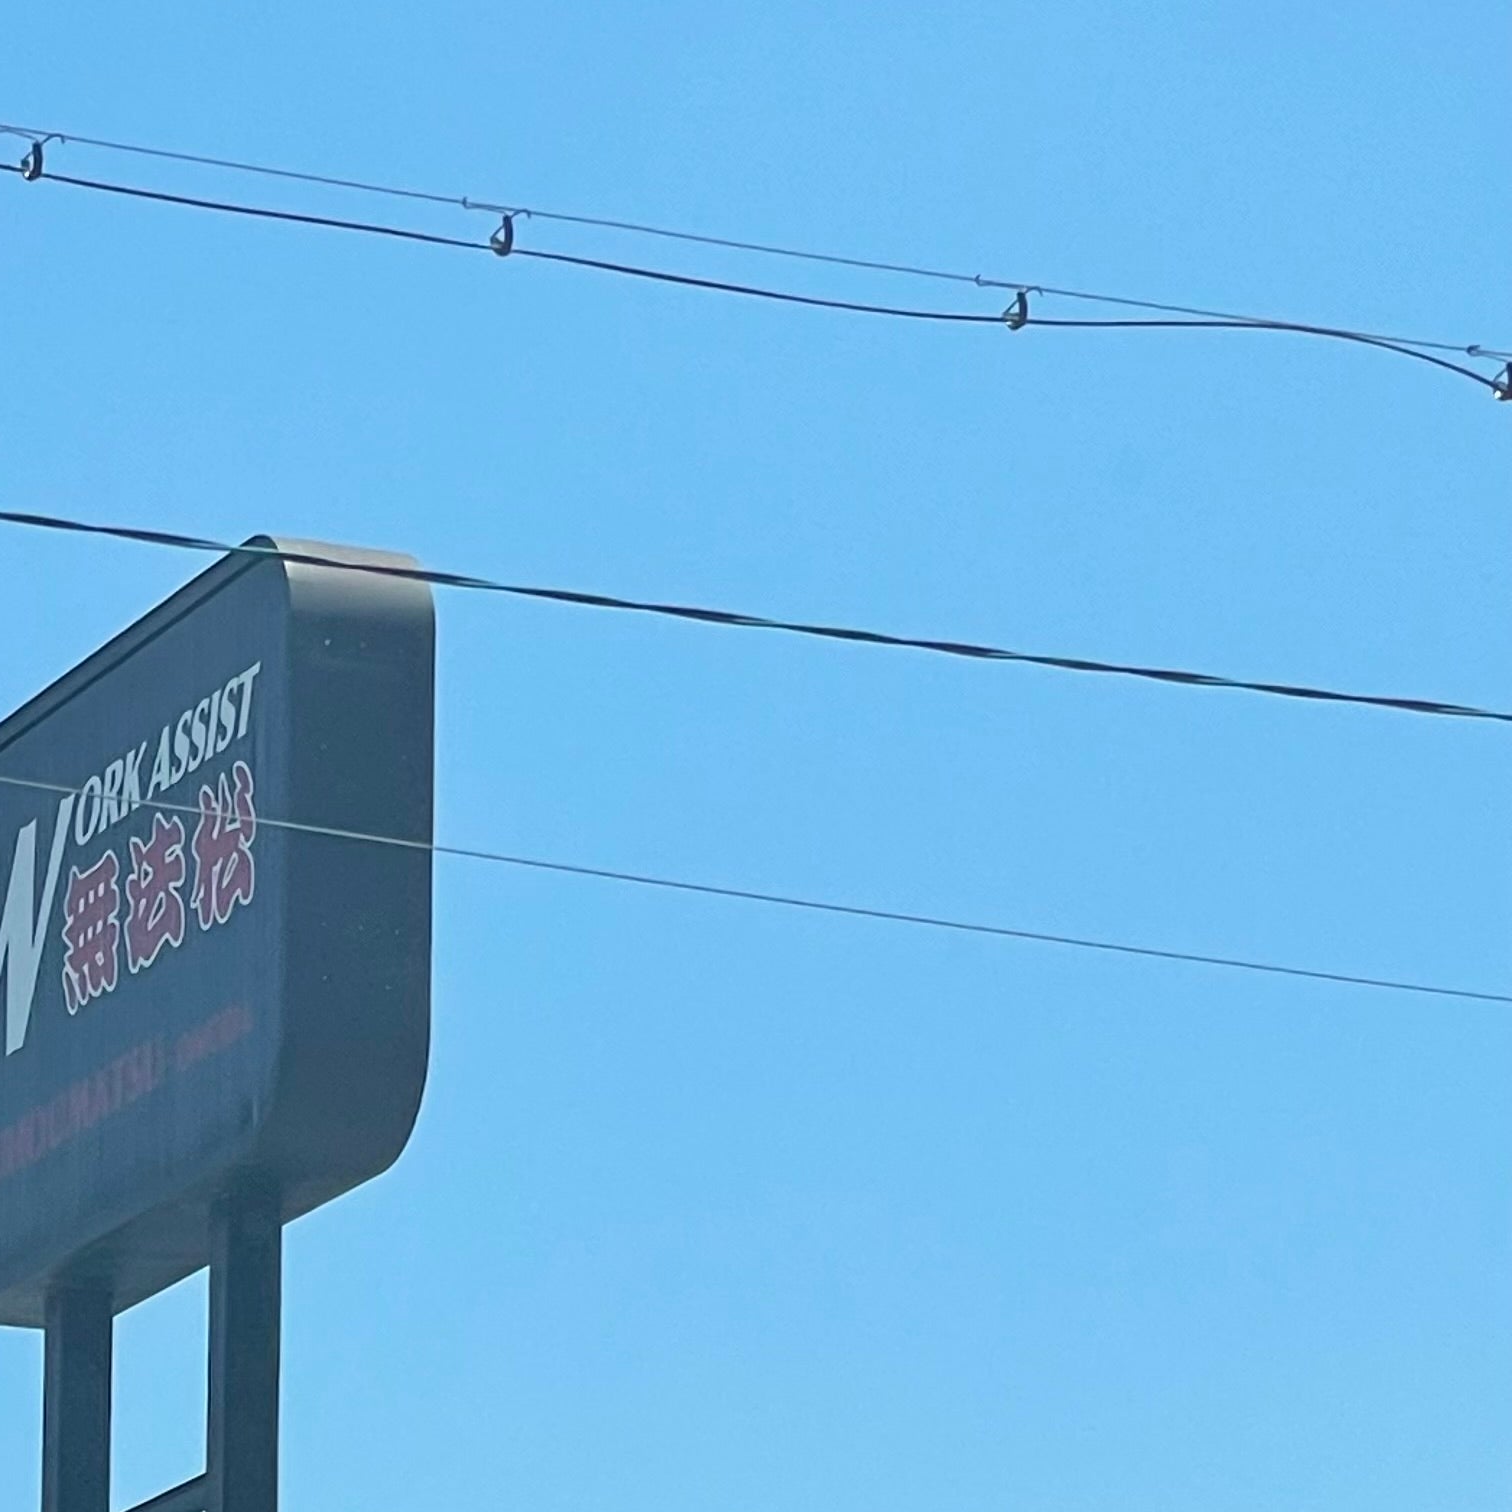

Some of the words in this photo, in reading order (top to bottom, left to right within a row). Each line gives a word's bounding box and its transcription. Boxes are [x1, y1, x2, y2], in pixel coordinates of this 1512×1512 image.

[146, 660, 261, 800] ASSIST
[61, 760, 256, 1016] 無法松
